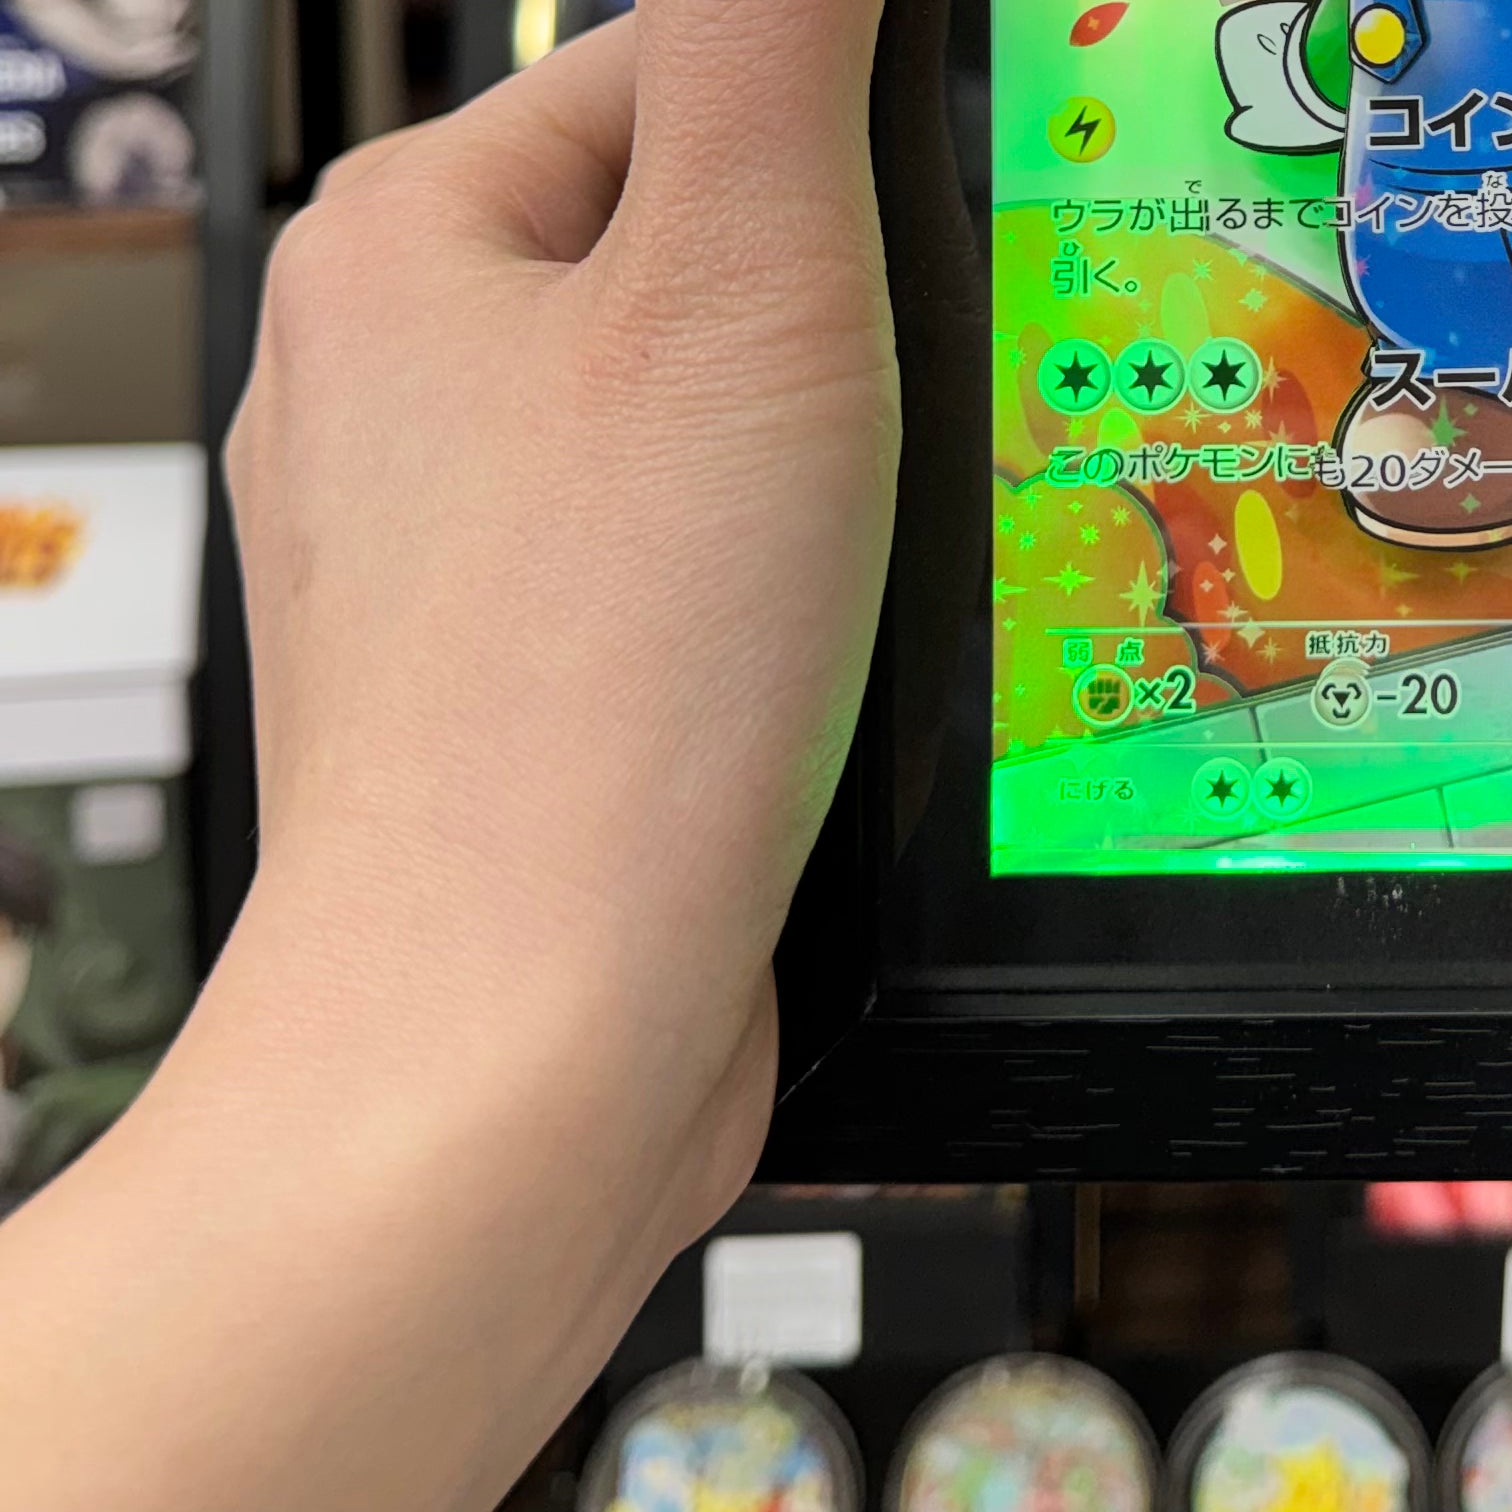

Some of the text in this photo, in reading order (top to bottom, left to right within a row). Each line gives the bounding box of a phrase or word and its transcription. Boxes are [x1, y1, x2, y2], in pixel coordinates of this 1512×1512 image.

[1053, 260, 1138, 294] 引く。
[1308, 632, 1387, 656] 抵抗力
